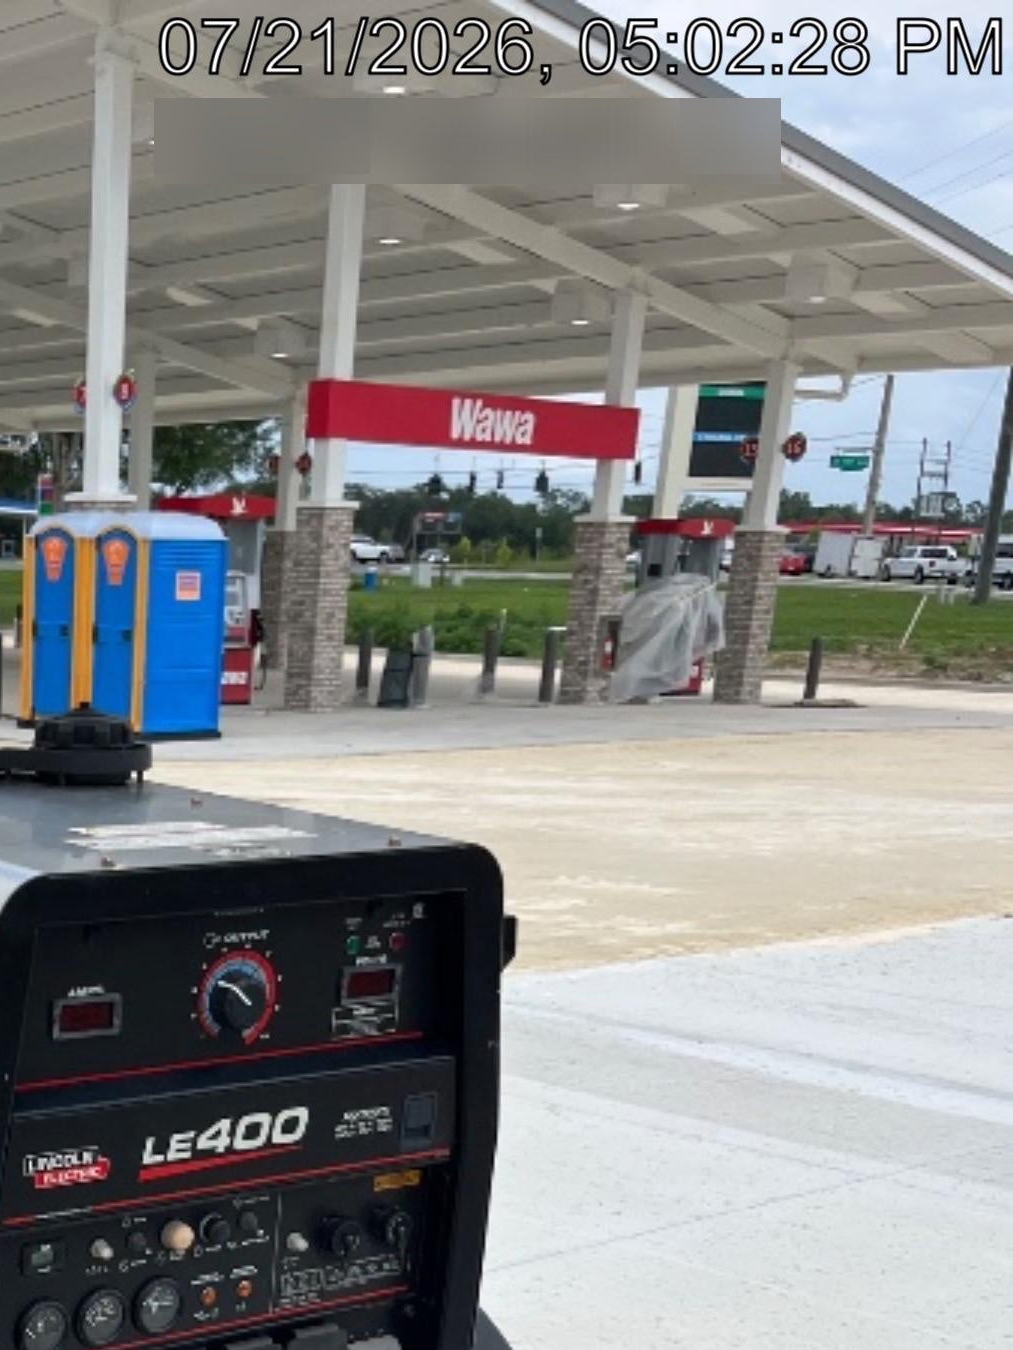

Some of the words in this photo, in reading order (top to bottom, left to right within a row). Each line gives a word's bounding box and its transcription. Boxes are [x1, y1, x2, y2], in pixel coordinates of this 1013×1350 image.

[450, 397, 536, 445] Wawa
[142, 1106, 309, 1165] LE400
[27, 1151, 94, 1175] LINCOLN
